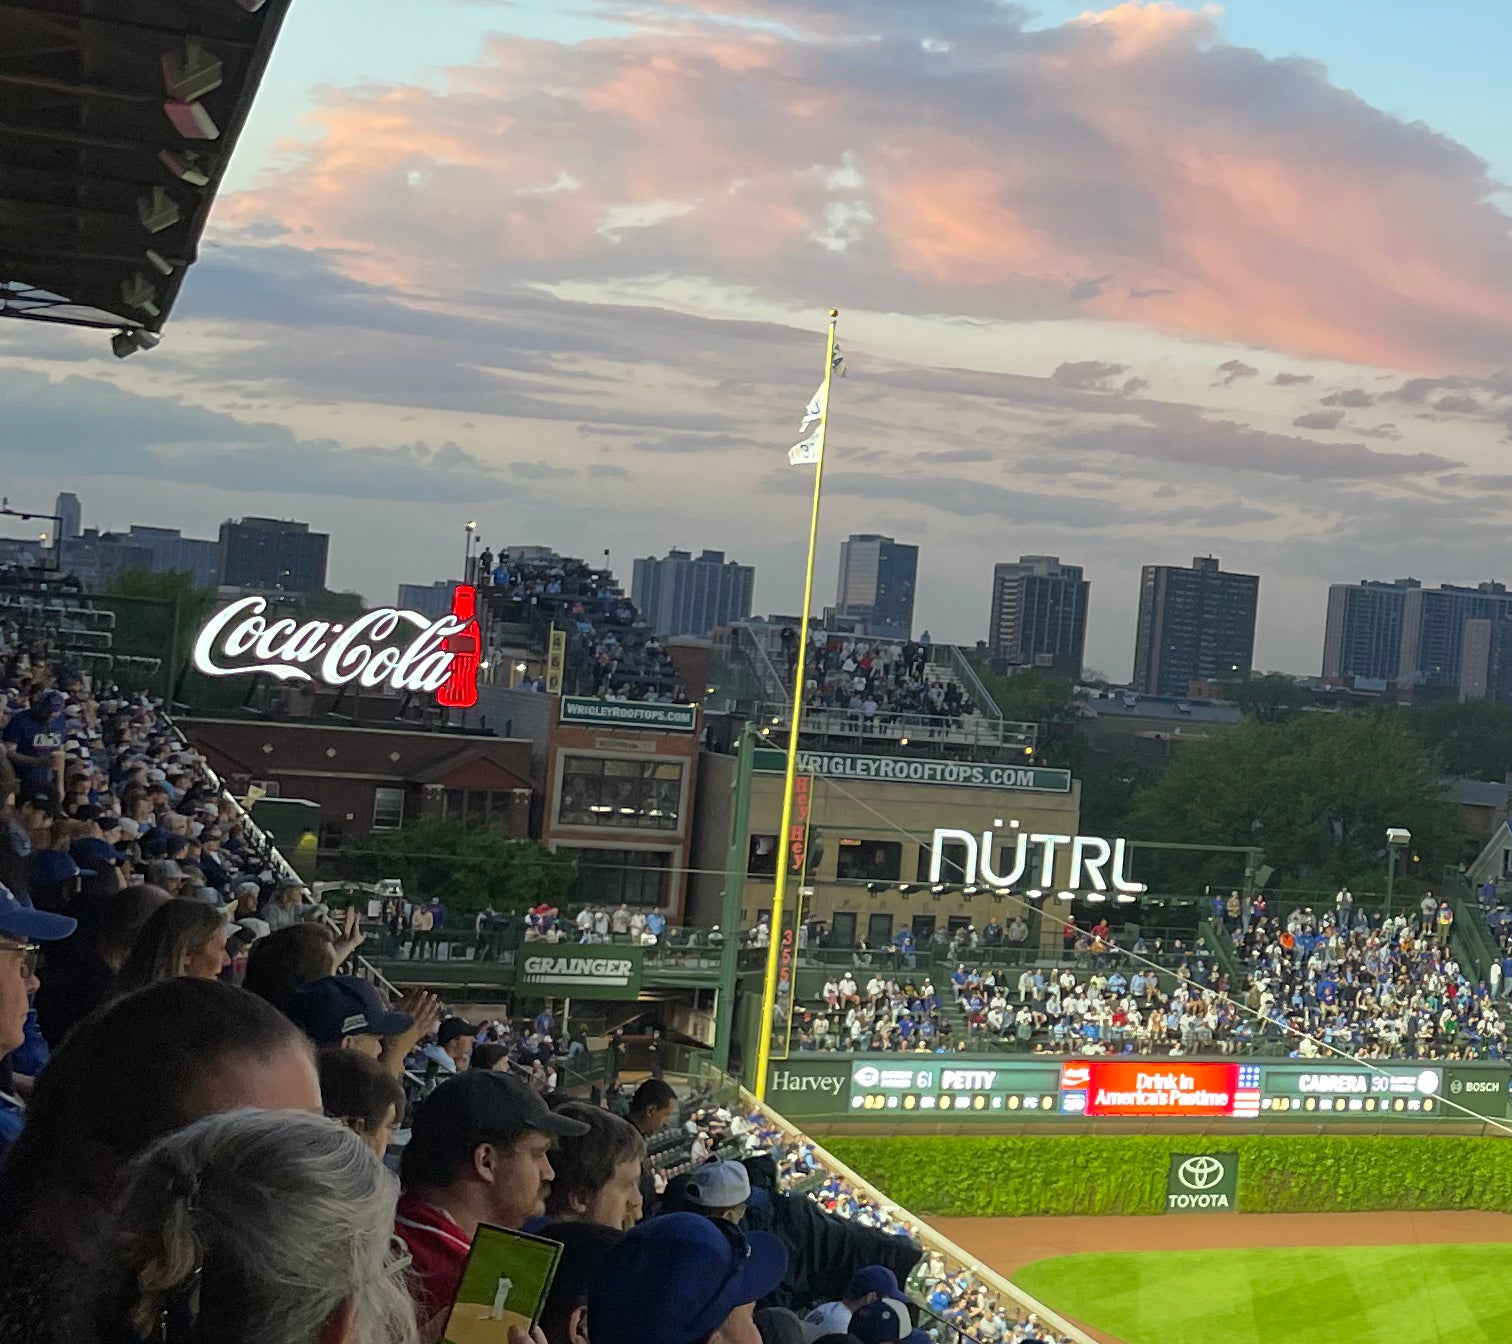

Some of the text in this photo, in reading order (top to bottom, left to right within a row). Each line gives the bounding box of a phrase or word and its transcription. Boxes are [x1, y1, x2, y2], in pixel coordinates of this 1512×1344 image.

[195, 596, 468, 691] Coca-Cola
[929, 819, 1144, 893] NÜTRL
[525, 956, 633, 977] GRAINGER
[772, 1071, 845, 1095] Harvey
[917, 1071, 932, 1089] 61
[941, 1070, 998, 1090] PETTY
[1136, 1073, 1194, 1090] Drink in
[1299, 1074, 1368, 1093] CABRERA
[1371, 1076, 1388, 1092] 30
[1465, 1082, 1500, 1093] BOSCH
[904, 1095, 916, 1109] 0
[939, 1095, 951, 1109] 0
[974, 1095, 985, 1109] 0
[1008, 1095, 1019, 1109] 0
[1042, 1095, 1053, 1109] 0
[1095, 1089, 1168, 1106] America's
[1170, 1090, 1229, 1107] Pastime
[1306, 1098, 1316, 1111] 0
[1336, 1098, 1346, 1111] 0
[1365, 1098, 1375, 1111] 0
[1394, 1098, 1404, 1111] 0
[1423, 1098, 1433, 1111] 0
[1168, 1194, 1229, 1208] TOYOTA
